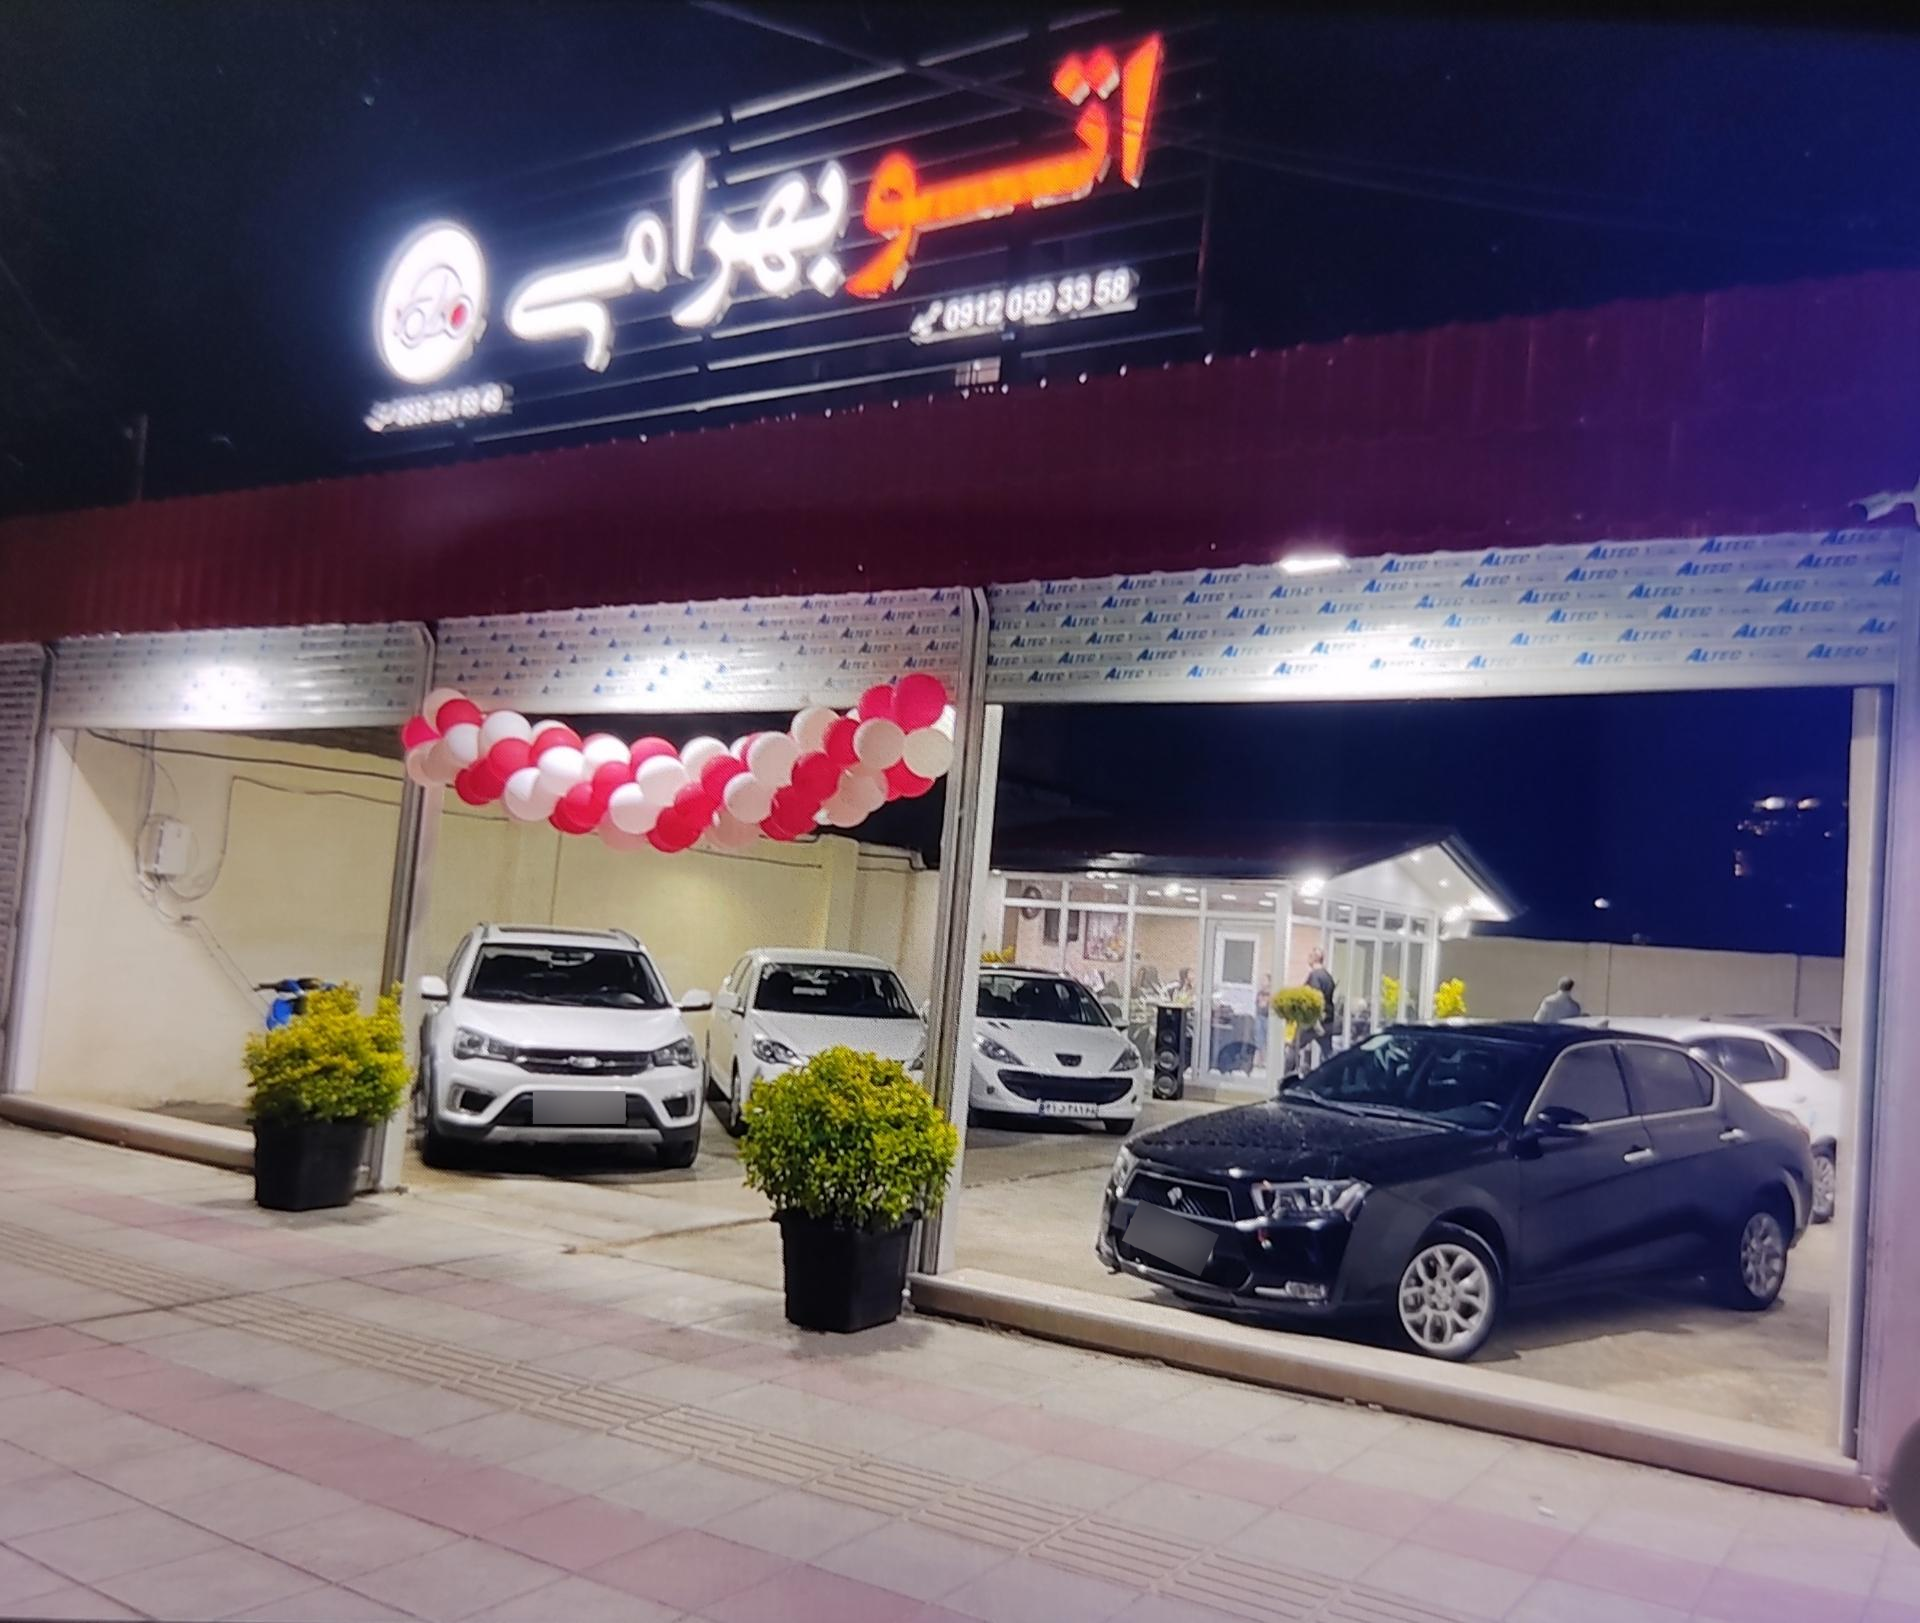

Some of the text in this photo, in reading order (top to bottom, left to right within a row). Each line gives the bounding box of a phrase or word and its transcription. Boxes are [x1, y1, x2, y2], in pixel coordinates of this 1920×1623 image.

[505, 33, 1162, 371] اتو بهرامی
[942, 267, 1130, 331] 0912 059 33 58
